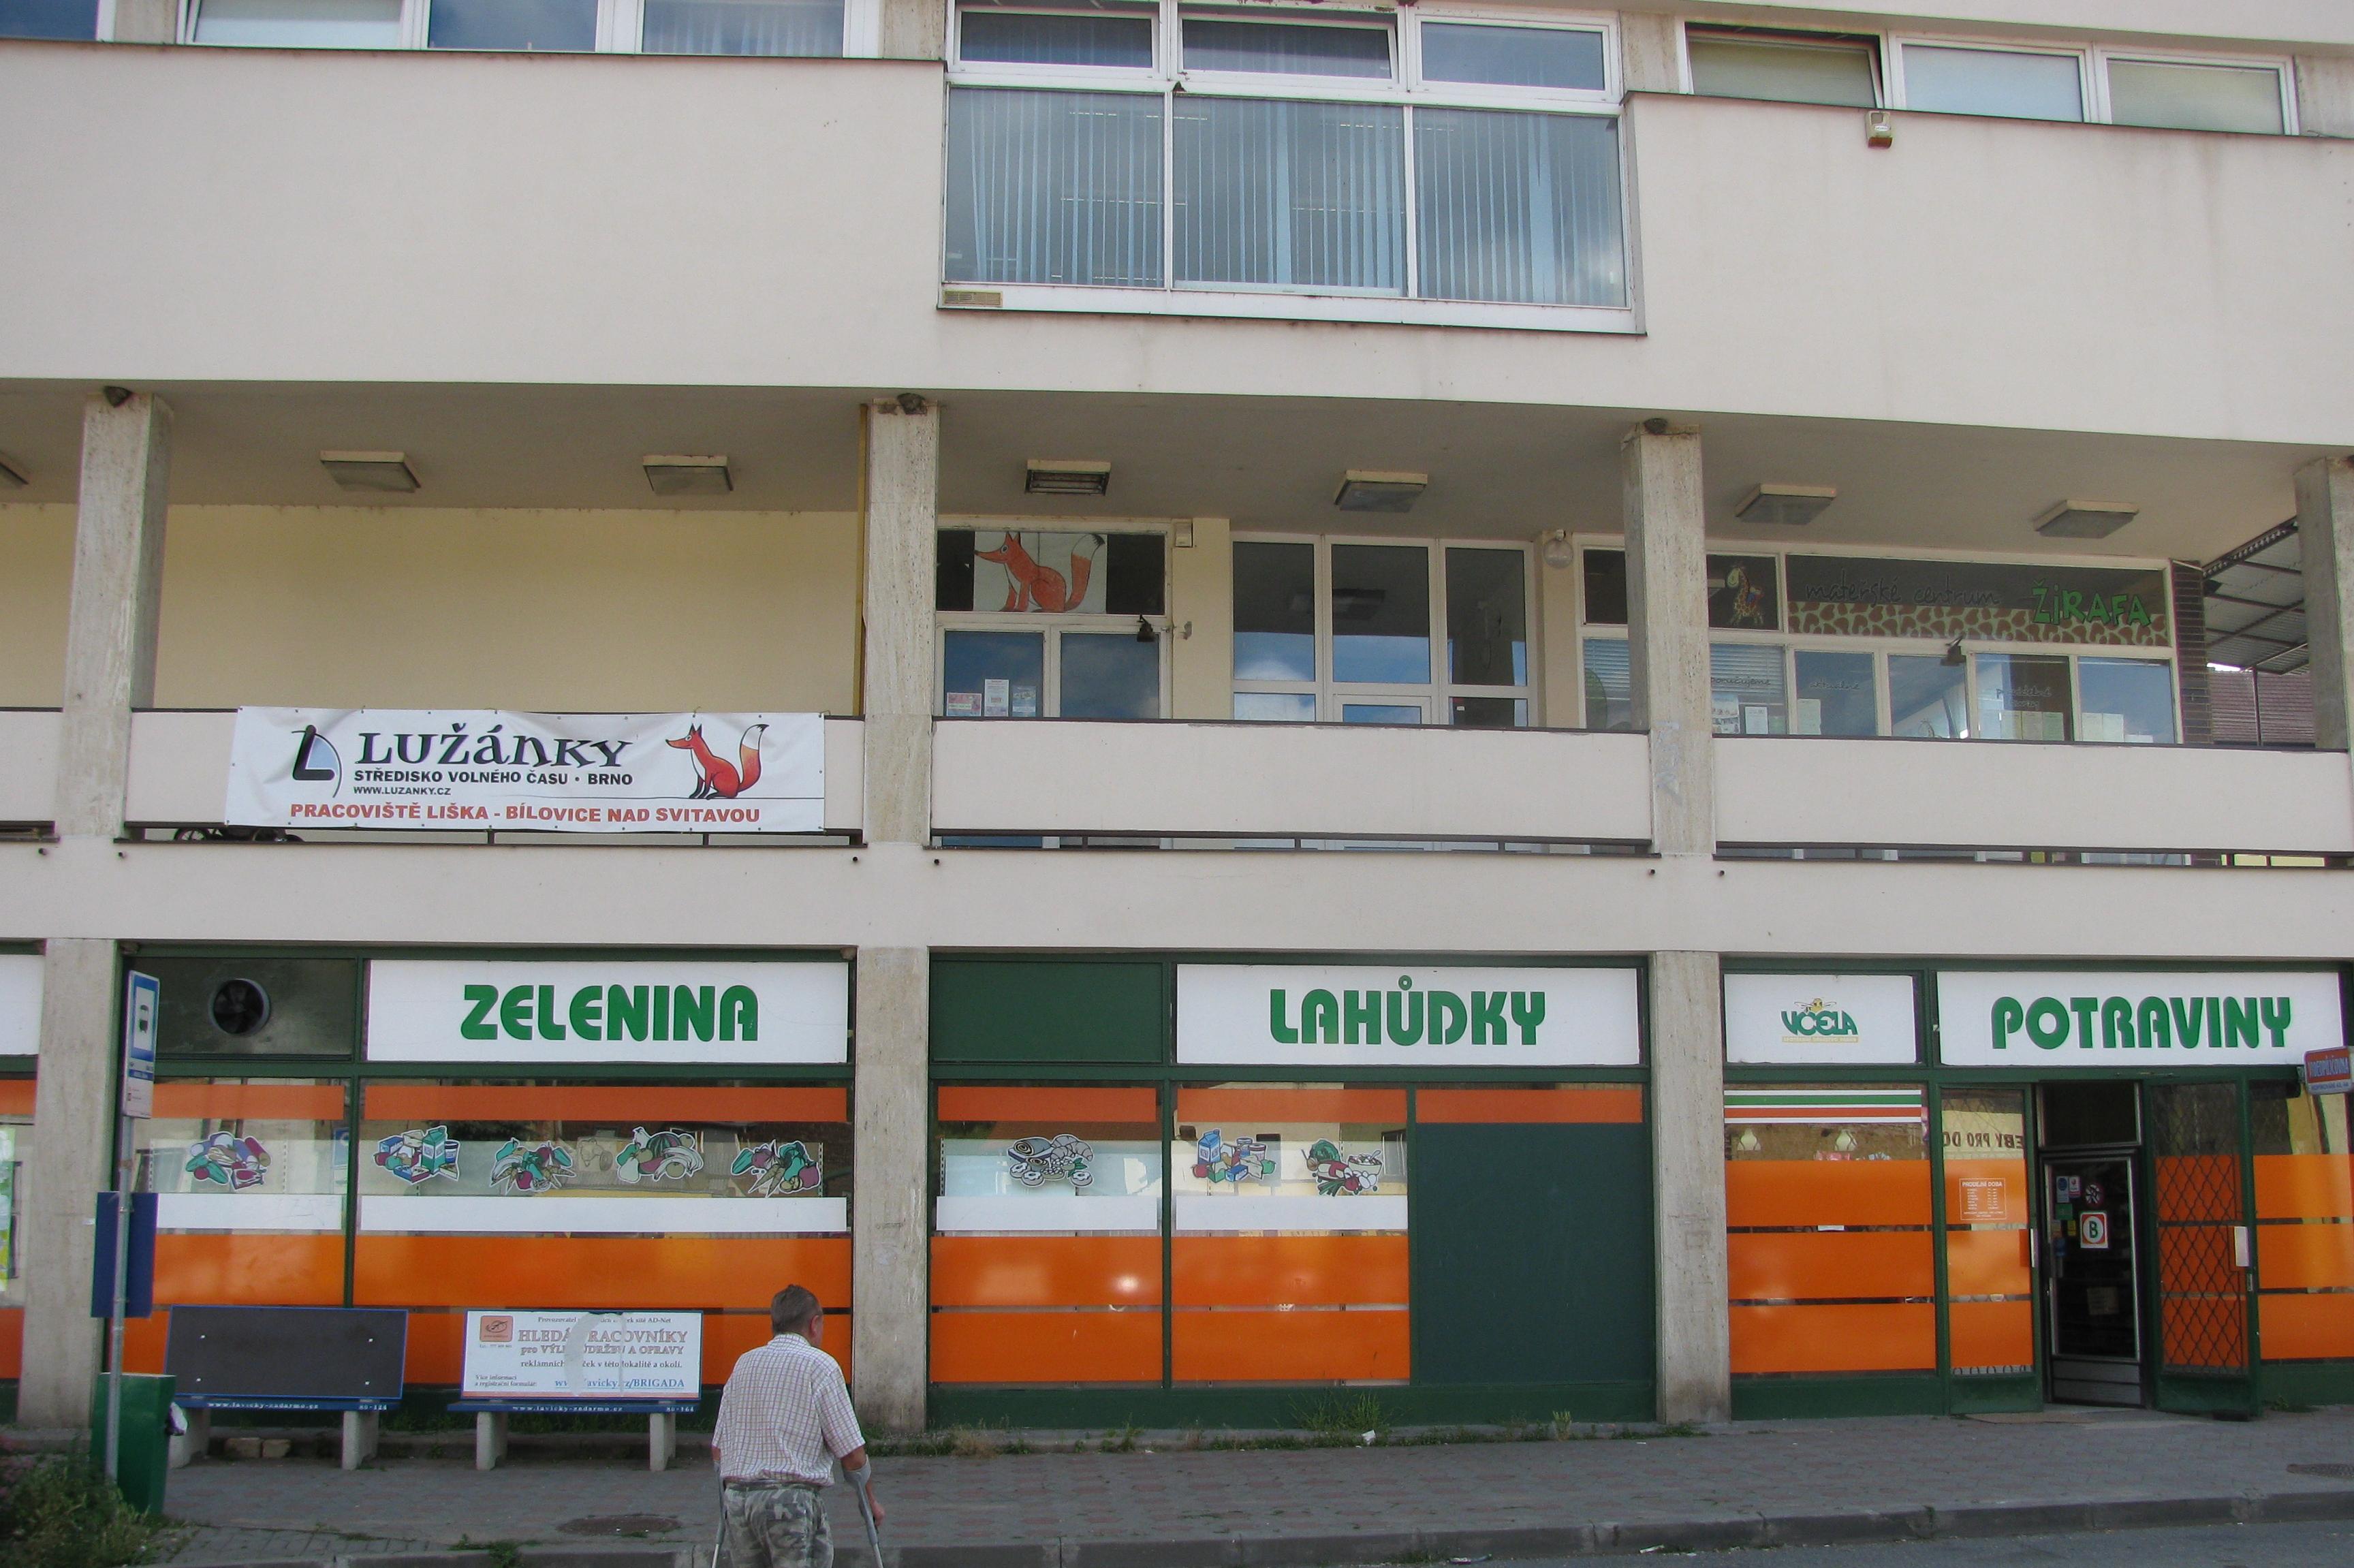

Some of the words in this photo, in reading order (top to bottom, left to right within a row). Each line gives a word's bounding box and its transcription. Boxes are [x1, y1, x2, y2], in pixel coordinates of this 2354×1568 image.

[1913, 574, 2000, 605] centrum
[354, 768, 443, 783] STŘEDISKO
[448, 769, 522, 783] VOLNÉHO
[527, 770, 568, 785] ČASU
[587, 773, 633, 785] BRNO
[354, 786, 452, 796] WWW.LUZANKY.CZ
[291, 802, 421, 819] PRACOVIŠTĚ
[427, 802, 488, 820] LIŠKA
[506, 802, 601, 823] BÍLOVICE
[608, 809, 650, 823] NAD
[655, 809, 760, 823] SVITAVOU
[460, 984, 758, 1041] ZELENINA
[1270, 975, 1545, 1046] LAHŮDKY
[1991, 996, 2291, 1050] POTRAVINY
[2089, 1221, 2098, 1238] B
[587, 1328, 688, 1343] RACOVNÍKY
[639, 1346, 685, 1355] OPRAVY
